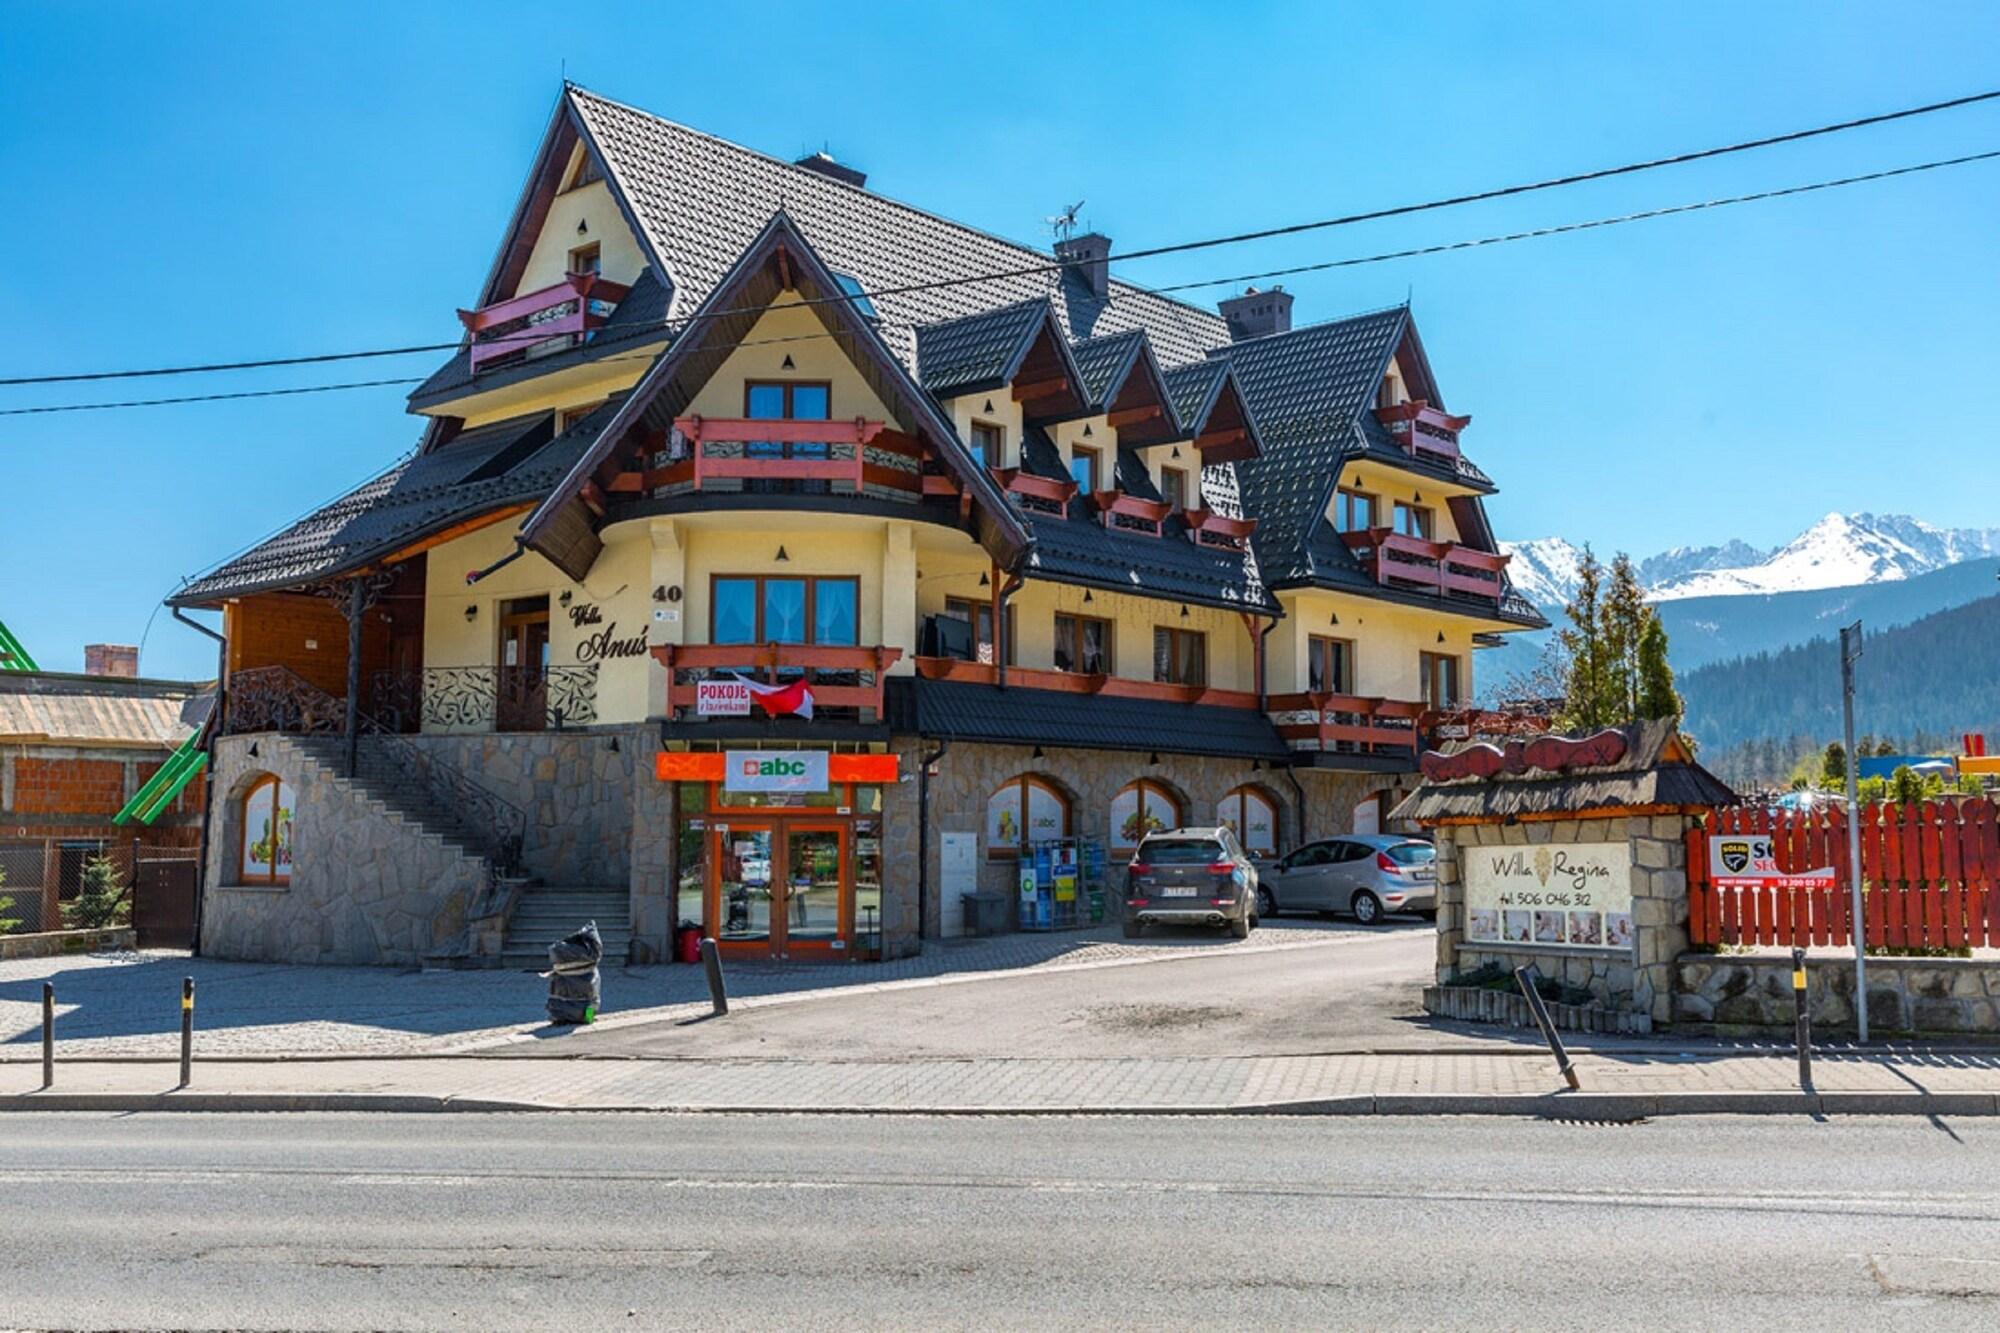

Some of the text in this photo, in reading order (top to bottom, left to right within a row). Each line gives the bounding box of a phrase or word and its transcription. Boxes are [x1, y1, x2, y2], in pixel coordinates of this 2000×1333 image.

[652, 585, 682, 602] 40
[569, 603, 602, 628] Willa
[576, 621, 649, 663] Anuś
[700, 685, 748, 699] POKOJE
[760, 757, 806, 776] abc
[1491, 850, 1610, 890] Willa Regina
[1517, 892, 1542, 906] 506
[1545, 892, 1571, 906] 046
